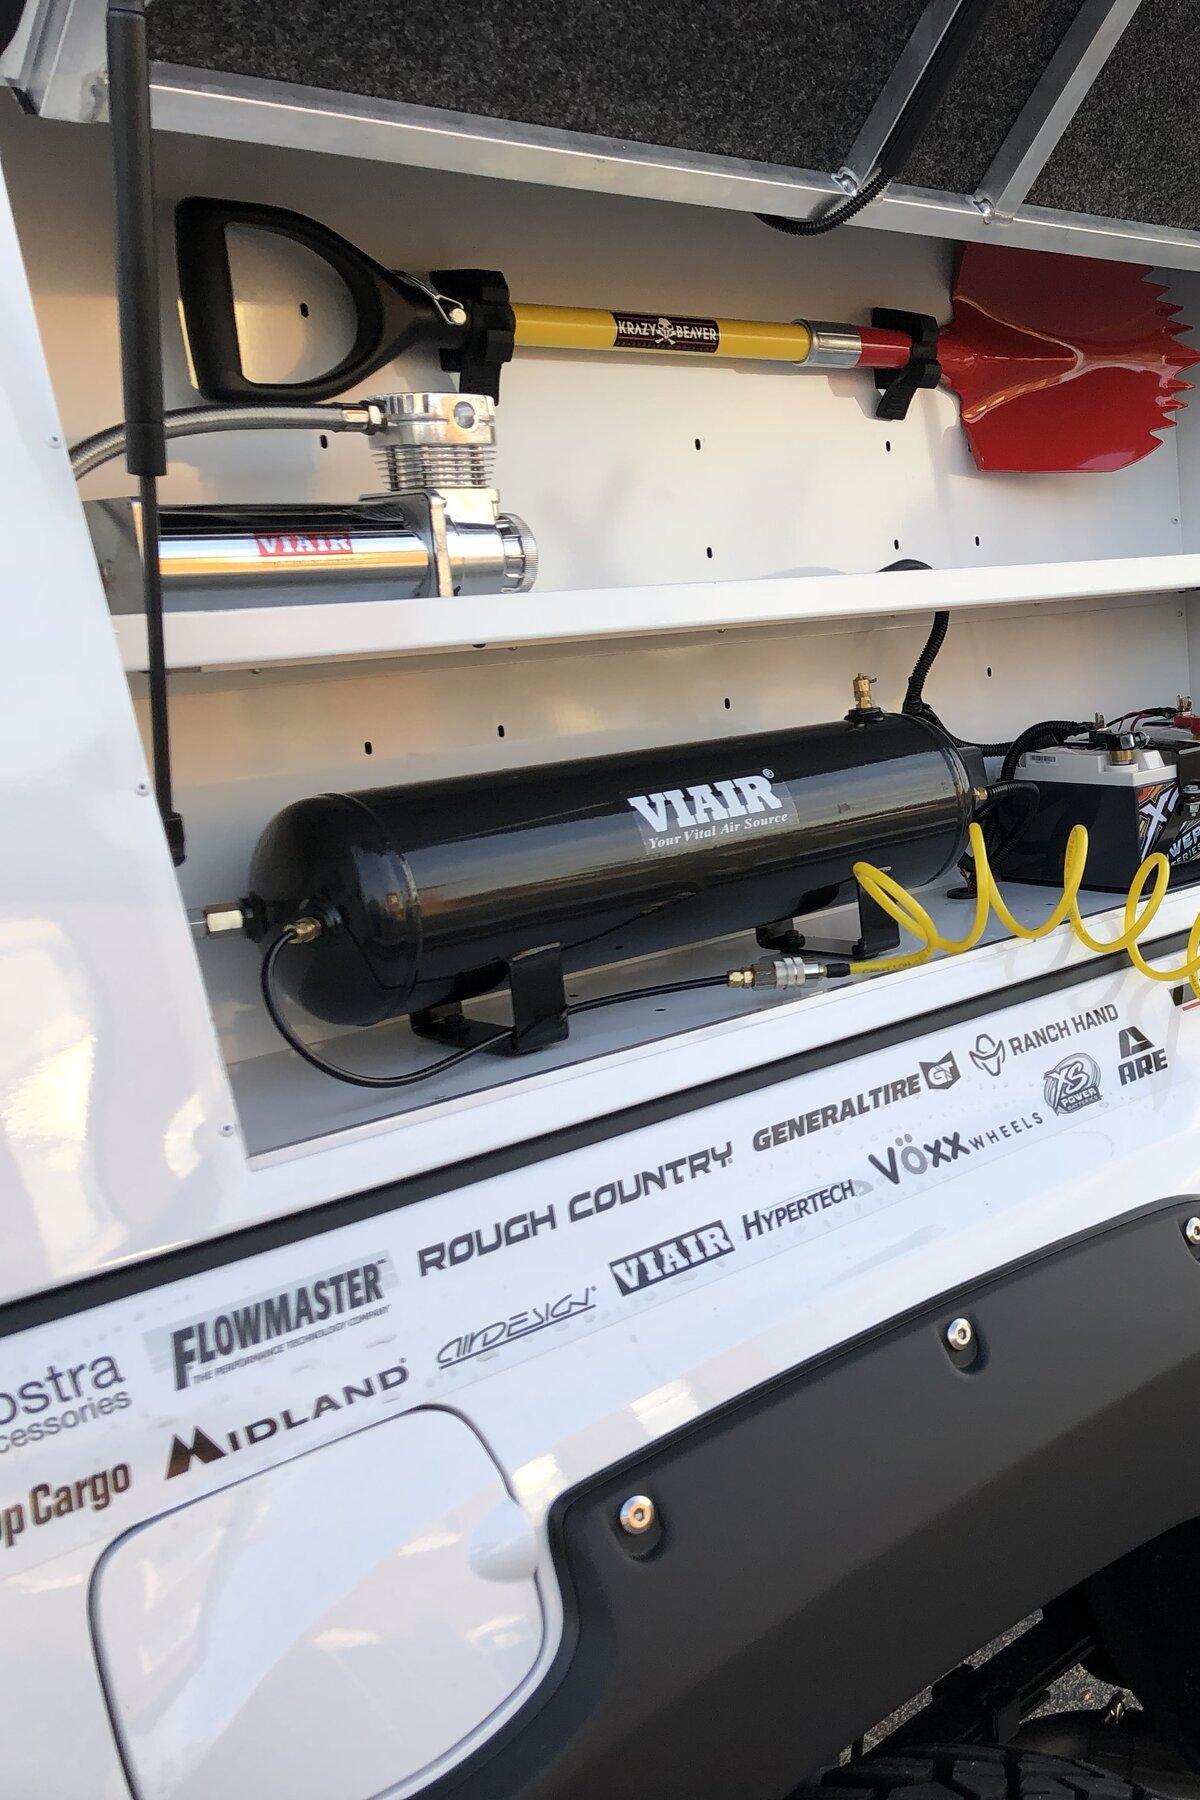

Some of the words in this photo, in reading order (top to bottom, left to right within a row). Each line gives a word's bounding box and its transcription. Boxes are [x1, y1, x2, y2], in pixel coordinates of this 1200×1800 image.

[618, 320, 657, 336] KRAZY
[676, 325, 718, 341] BEAVER
[255, 534, 352, 555] VIAIR
[627, 775, 783, 833] VIAIR
[649, 834, 682, 850] Your
[683, 825, 717, 842] Vital
[720, 820, 740, 835] Air
[744, 812, 788, 830] Source
[1008, 1020, 1071, 1056] RANCH
[1071, 1003, 1119, 1035] HAND
[1043, 1060, 1090, 1114] XS
[1118, 1048, 1169, 1086] ARE
[1060, 1087, 1097, 1108] POWER
[969, 1112, 1043, 1150] WHEELS
[417, 1203, 557, 1277] ROUGH
[568, 1141, 733, 1223] COUNTRY
[742, 1179, 856, 1241] HYPERTECH
[610, 1225, 733, 1291] VIAIR
[171, 1263, 385, 1392] FLOWMASTER
[164, 1364, 410, 1481] MIDLAND
[31, 1462, 130, 1526] Cargo
